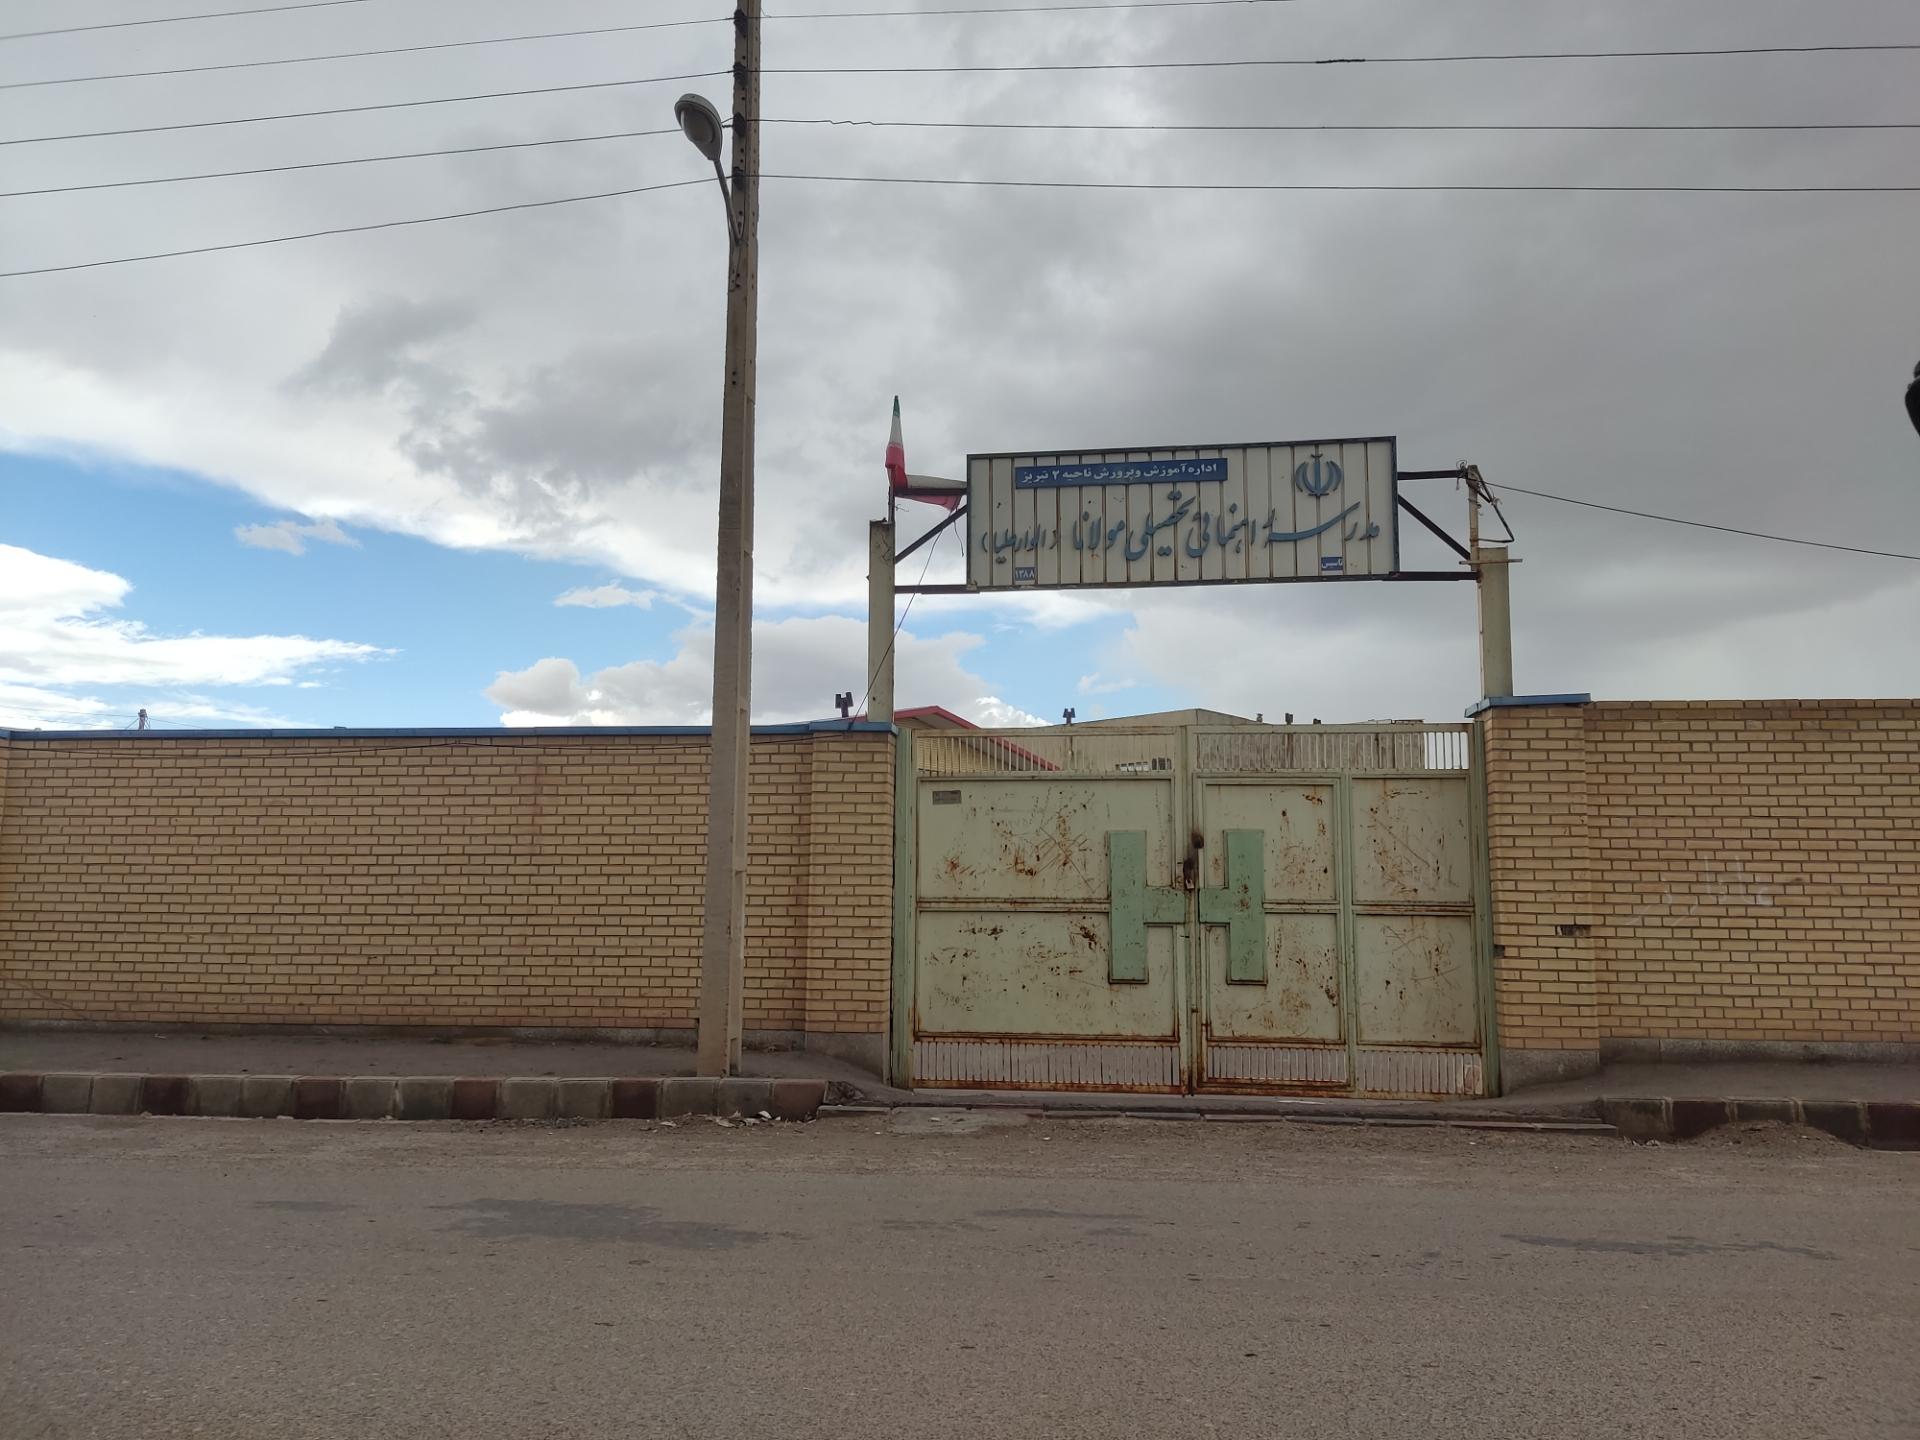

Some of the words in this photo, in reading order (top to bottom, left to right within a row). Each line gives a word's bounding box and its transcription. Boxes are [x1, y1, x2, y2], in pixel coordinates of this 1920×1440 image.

[1052, 470, 1060, 480] ۲
[1062, 468, 1092, 480] ناحیه
[1144, 464, 1187, 478] آموزش
[1188, 463, 1217, 476] اداره
[1021, 471, 1049, 484] تبریز
[1072, 511, 1125, 550] مولانا
[1125, 489, 1196, 561] تحصیلی
[1015, 569, 1035, 579] ۱۳۸۸
